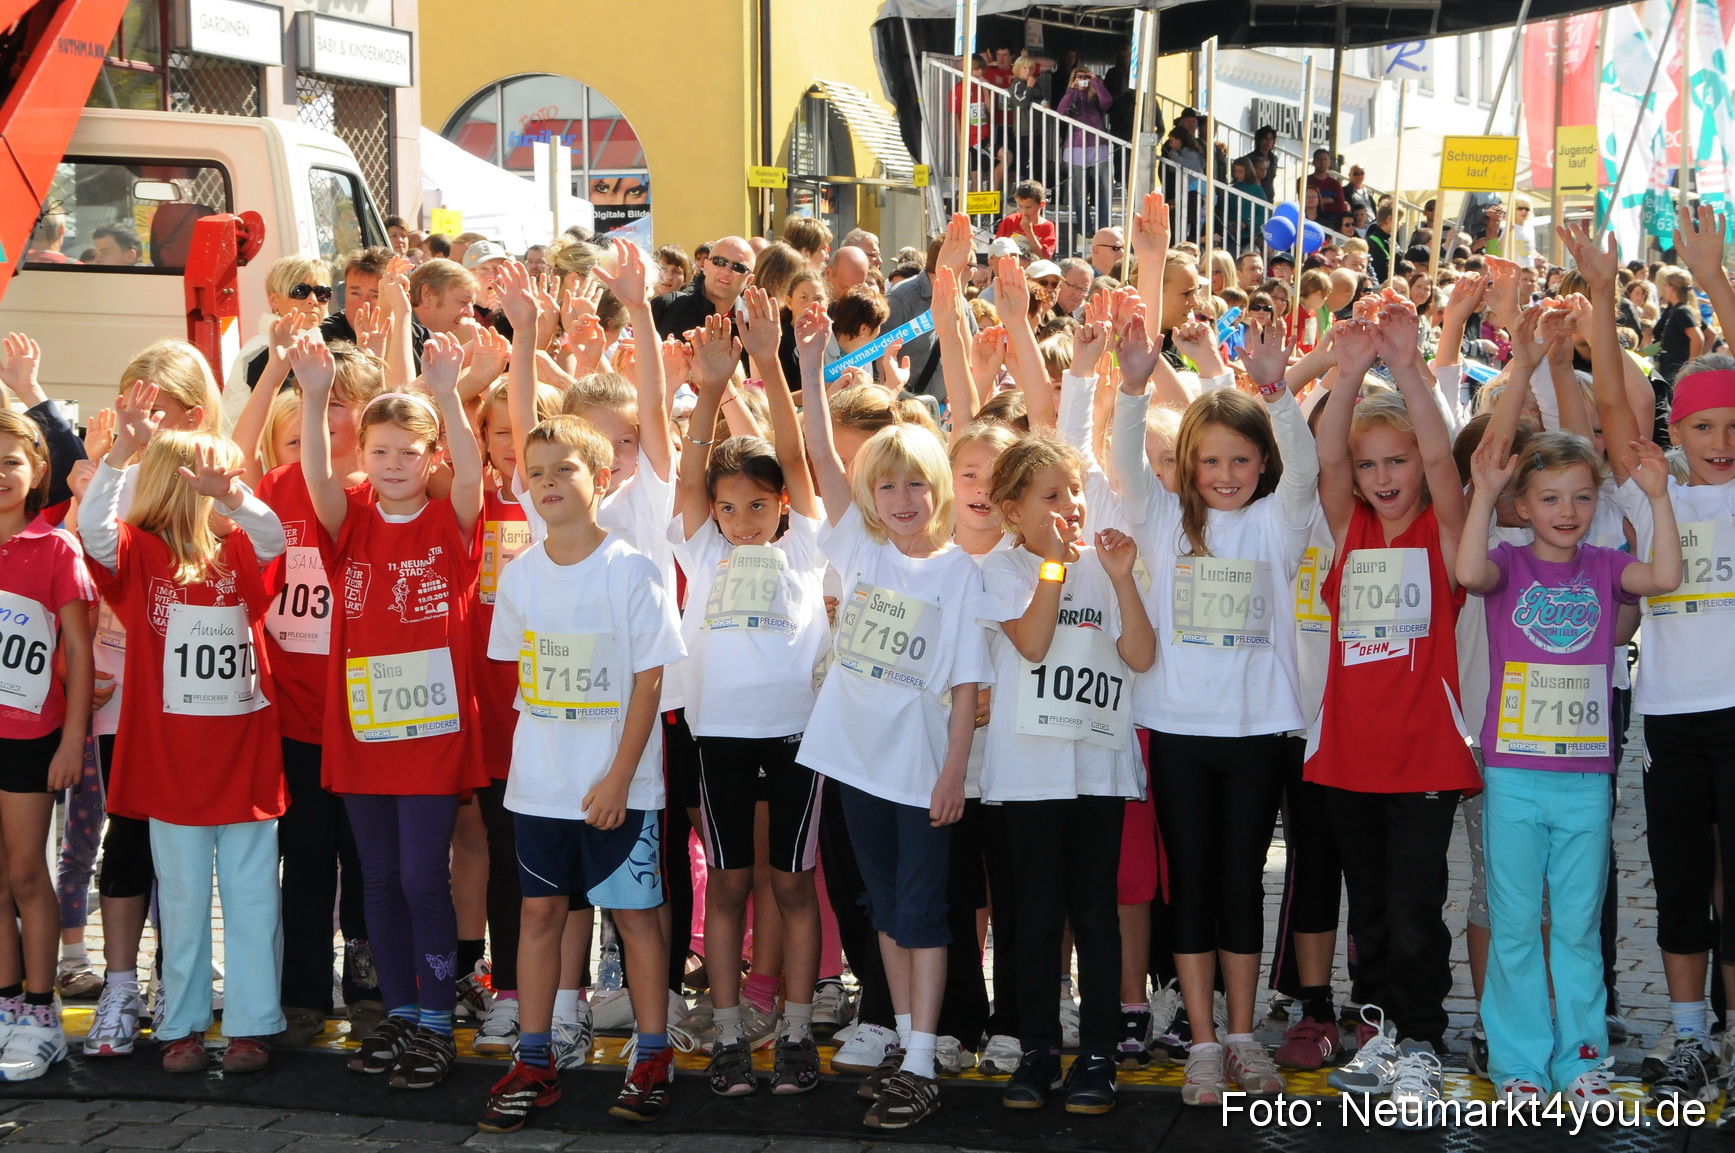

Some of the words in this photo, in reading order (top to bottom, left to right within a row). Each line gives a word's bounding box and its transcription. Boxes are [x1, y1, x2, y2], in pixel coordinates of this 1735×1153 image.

[200, 13, 250, 37] GARDINEN
[58, 37, 106, 59] RUTHMANN
[317, 35, 337, 52] BABY
[340, 41, 346, 55] &
[349, 43, 407, 66] KINDERMODEN
[518, 105, 559, 133] FOTO
[1446, 151, 1512, 165] Schnupper-
[1558, 144, 1597, 157] Jugend-
[1568, 157, 1587, 168] lauf
[1466, 167, 1489, 177] lauf
[828, 326, 910, 377] www.maxi-dsl.de
[501, 527, 532, 544] Karin
[1680, 529, 1698, 547] ah
[388, 562, 400, 571] 11.
[484, 552, 493, 564] K3
[1352, 557, 1387, 574] Laura
[1200, 563, 1252, 583] Luciana
[1300, 579, 1310, 591] K3
[1176, 589, 1189, 602] K3
[1353, 582, 1421, 610] 7040
[870, 593, 906, 620] Sarah
[1201, 592, 1266, 620] 7049
[1513, 585, 1600, 628] Fever
[760, 616, 797, 630] PFLEIDERER
[844, 611, 856, 626] K3
[1057, 607, 1102, 626] RRIDA
[190, 620, 235, 636] Annika
[287, 631, 319, 640] PFLEIDERER
[1387, 623, 1428, 633] PFLEIDERER
[540, 638, 569, 657] Elisa
[861, 619, 927, 661] 7190
[1235, 635, 1270, 645] PFLEIDERER
[0, 630, 47, 676] 06
[1359, 641, 1390, 657] DEHN
[373, 662, 403, 679] Sina
[522, 662, 531, 675] K3
[542, 666, 611, 692] 7154
[884, 669, 924, 687] PFLEIDERER
[1530, 670, 1590, 690] Susanna
[352, 689, 365, 703] K3
[1030, 664, 1123, 712] 10207
[377, 682, 447, 713] 7008
[1505, 695, 1518, 709] K3
[577, 707, 619, 716] PFLEIDERER
[1531, 699, 1600, 726] 7198
[418, 718, 458, 731] PFLEIDERER
[1049, 715, 1083, 726] PFLEIDERER
[1568, 742, 1607, 751] PFLEIDERER
